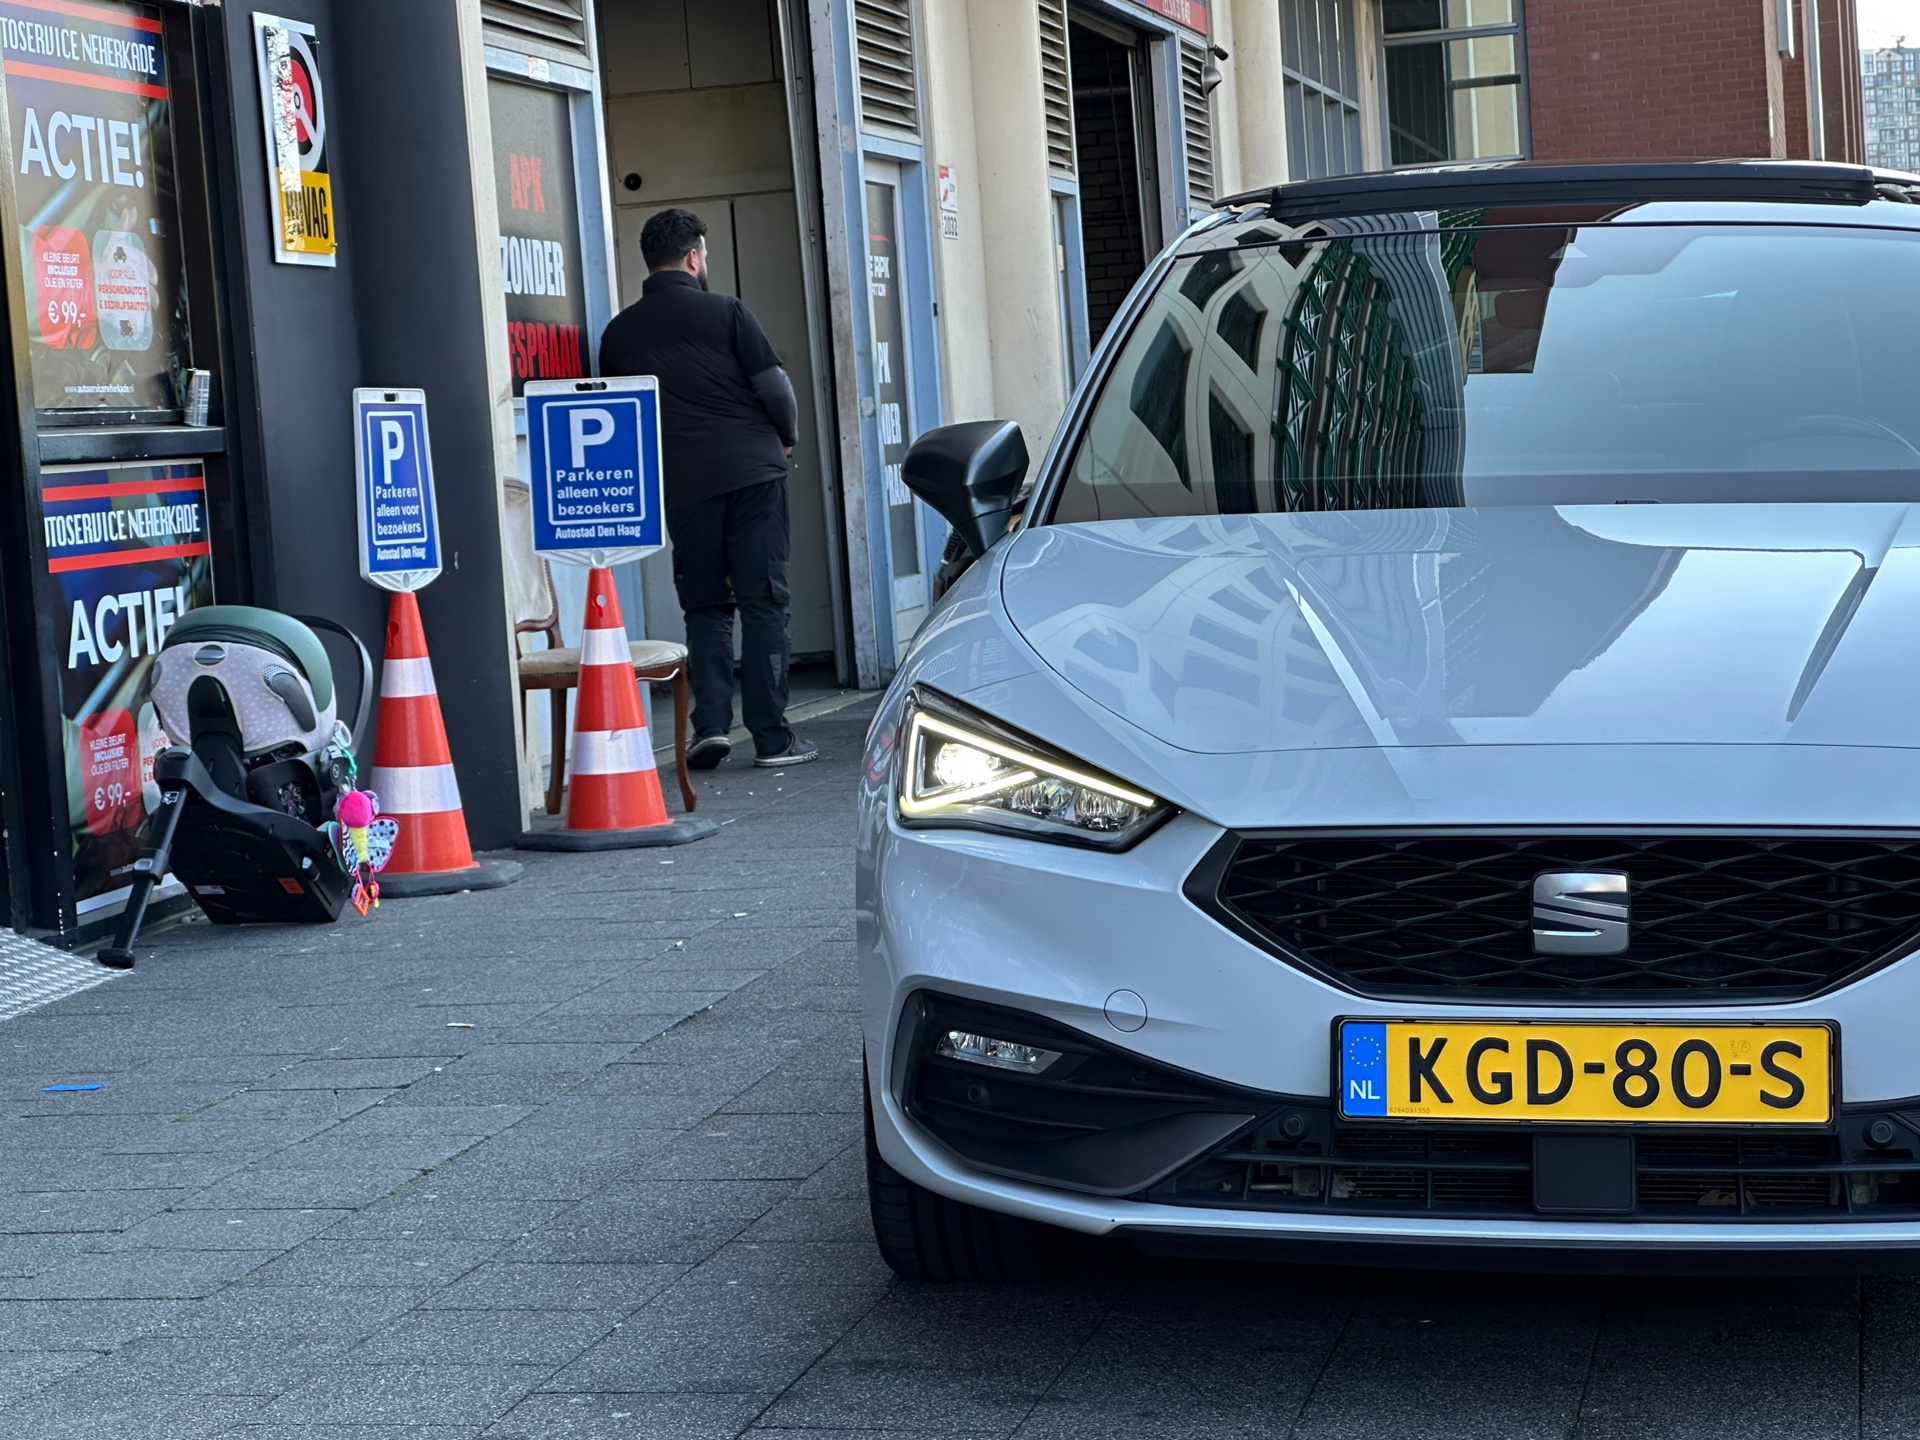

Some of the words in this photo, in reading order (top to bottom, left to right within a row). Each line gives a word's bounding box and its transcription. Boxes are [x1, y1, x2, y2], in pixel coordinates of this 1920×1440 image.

[81, 32, 157, 75] NEHERKADE
[20, 107, 144, 188] ACTIE!
[509, 152, 545, 213] APK
[43, 252, 61, 263] KLEINE
[62, 253, 80, 264] BEURT
[499, 236, 566, 297] ZONDER
[47, 264, 78, 276] INCLUSIEF
[44, 276, 57, 288] OLIE
[57, 277, 66, 288] EN
[66, 278, 84, 289] FILTER
[48, 300, 59, 324] €
[61, 300, 86, 328] 99,-
[569, 408, 615, 468] P
[380, 420, 405, 485] P
[556, 468, 633, 483] Parkeren
[375, 485, 418, 499] Parkeren
[557, 486, 599, 500] alleen
[601, 486, 635, 497] voor
[376, 503, 400, 517] alleen
[401, 504, 420, 516] voor
[558, 501, 635, 516] bezoekers
[127, 503, 200, 539] NEHERKADE
[377, 520, 422, 536] bezoekers
[555, 525, 596, 540] Autostad
[597, 525, 616, 537] Den
[617, 524, 641, 538] Haag
[376, 546, 400, 561] Autostad
[401, 546, 411, 559] Den
[412, 545, 426, 560] Haag
[90, 738, 108, 751] KLEINE
[108, 733, 126, 747] BEURT
[94, 746, 124, 762] INCLUSIEF
[91, 763, 104, 776] OLIE
[104, 761, 112, 773] EN
[112, 757, 129, 771] FILTER
[94, 787, 105, 811] €
[107, 782, 131, 808] 99,-
[1407, 1036, 1806, 1109] KGD-80-S
[1349, 1080, 1381, 1101] NL
